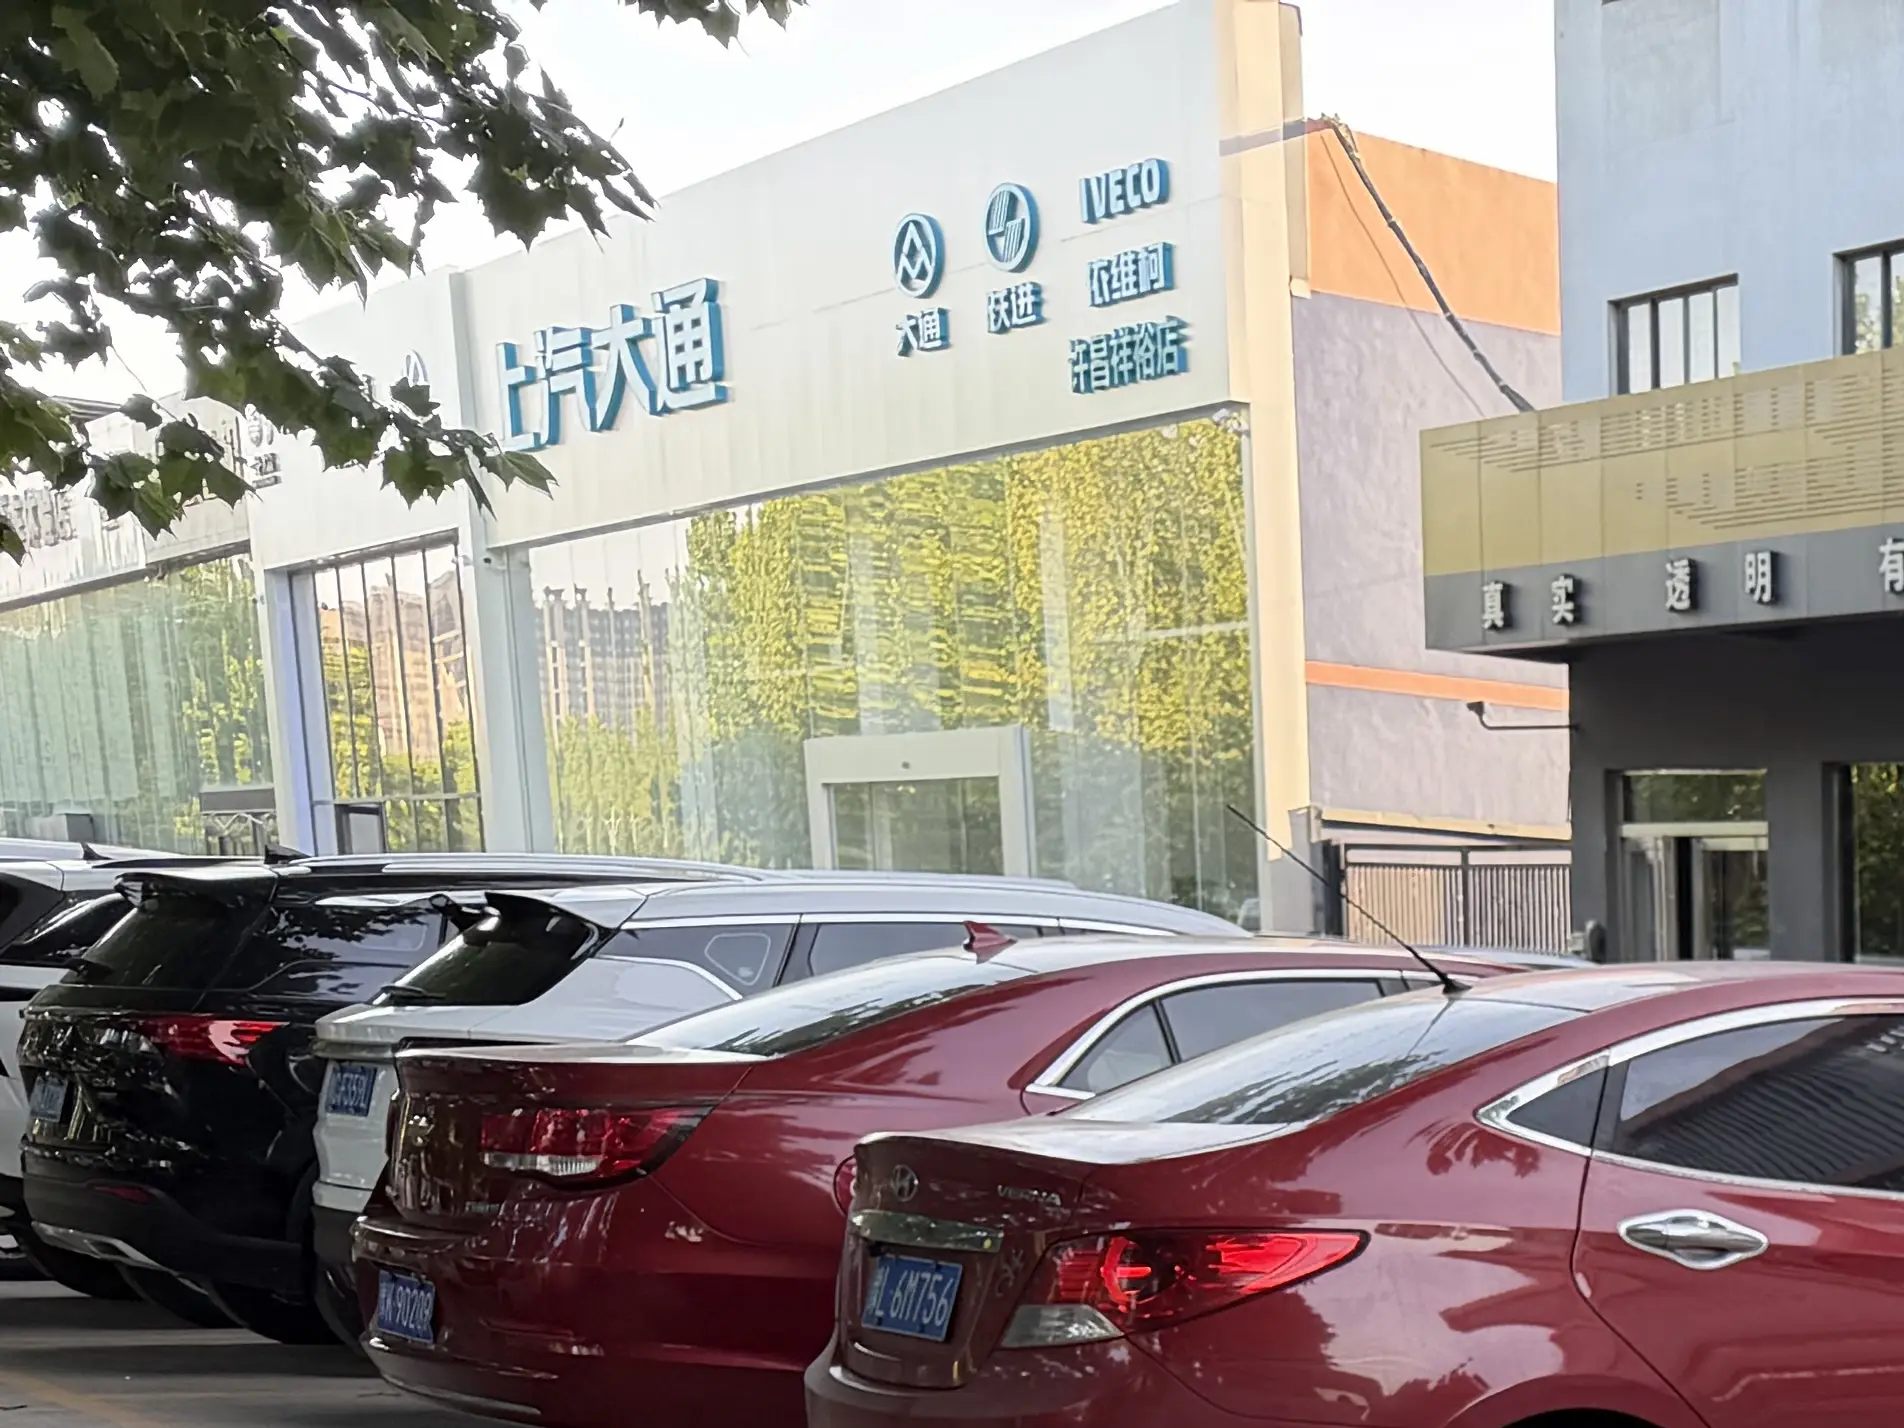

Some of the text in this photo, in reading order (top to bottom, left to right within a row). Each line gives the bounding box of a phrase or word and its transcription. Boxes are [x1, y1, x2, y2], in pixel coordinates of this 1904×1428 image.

[1079, 158, 1168, 224] IVECO
[1088, 242, 1174, 306] 依维柯
[896, 307, 949, 356] 大通
[987, 282, 1046, 334] 跃进
[496, 277, 728, 452] 上汽大通
[1069, 315, 1189, 394] 许昌祥裕店
[1480, 573, 1582, 631] 真实
[1664, 551, 1780, 613] 透明
